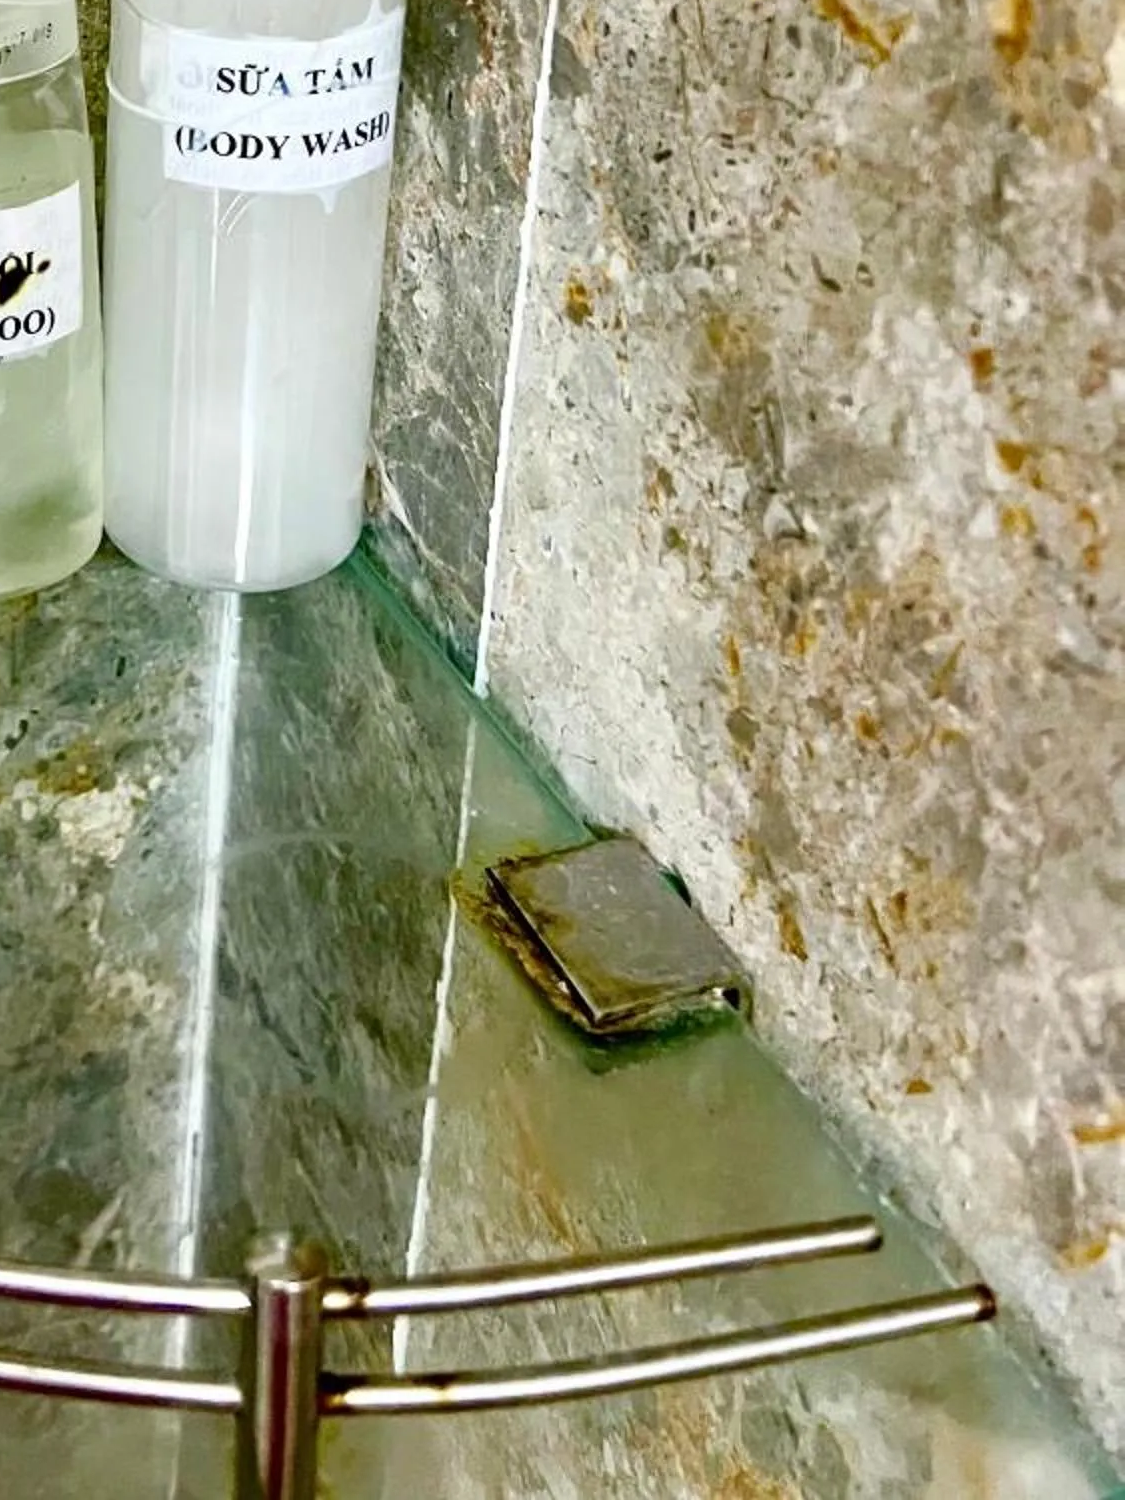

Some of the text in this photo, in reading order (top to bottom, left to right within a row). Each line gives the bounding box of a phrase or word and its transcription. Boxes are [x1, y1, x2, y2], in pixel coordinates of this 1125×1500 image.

[216, 63, 291, 96] SỮA
[176, 111, 390, 160] (BODY WASH)
